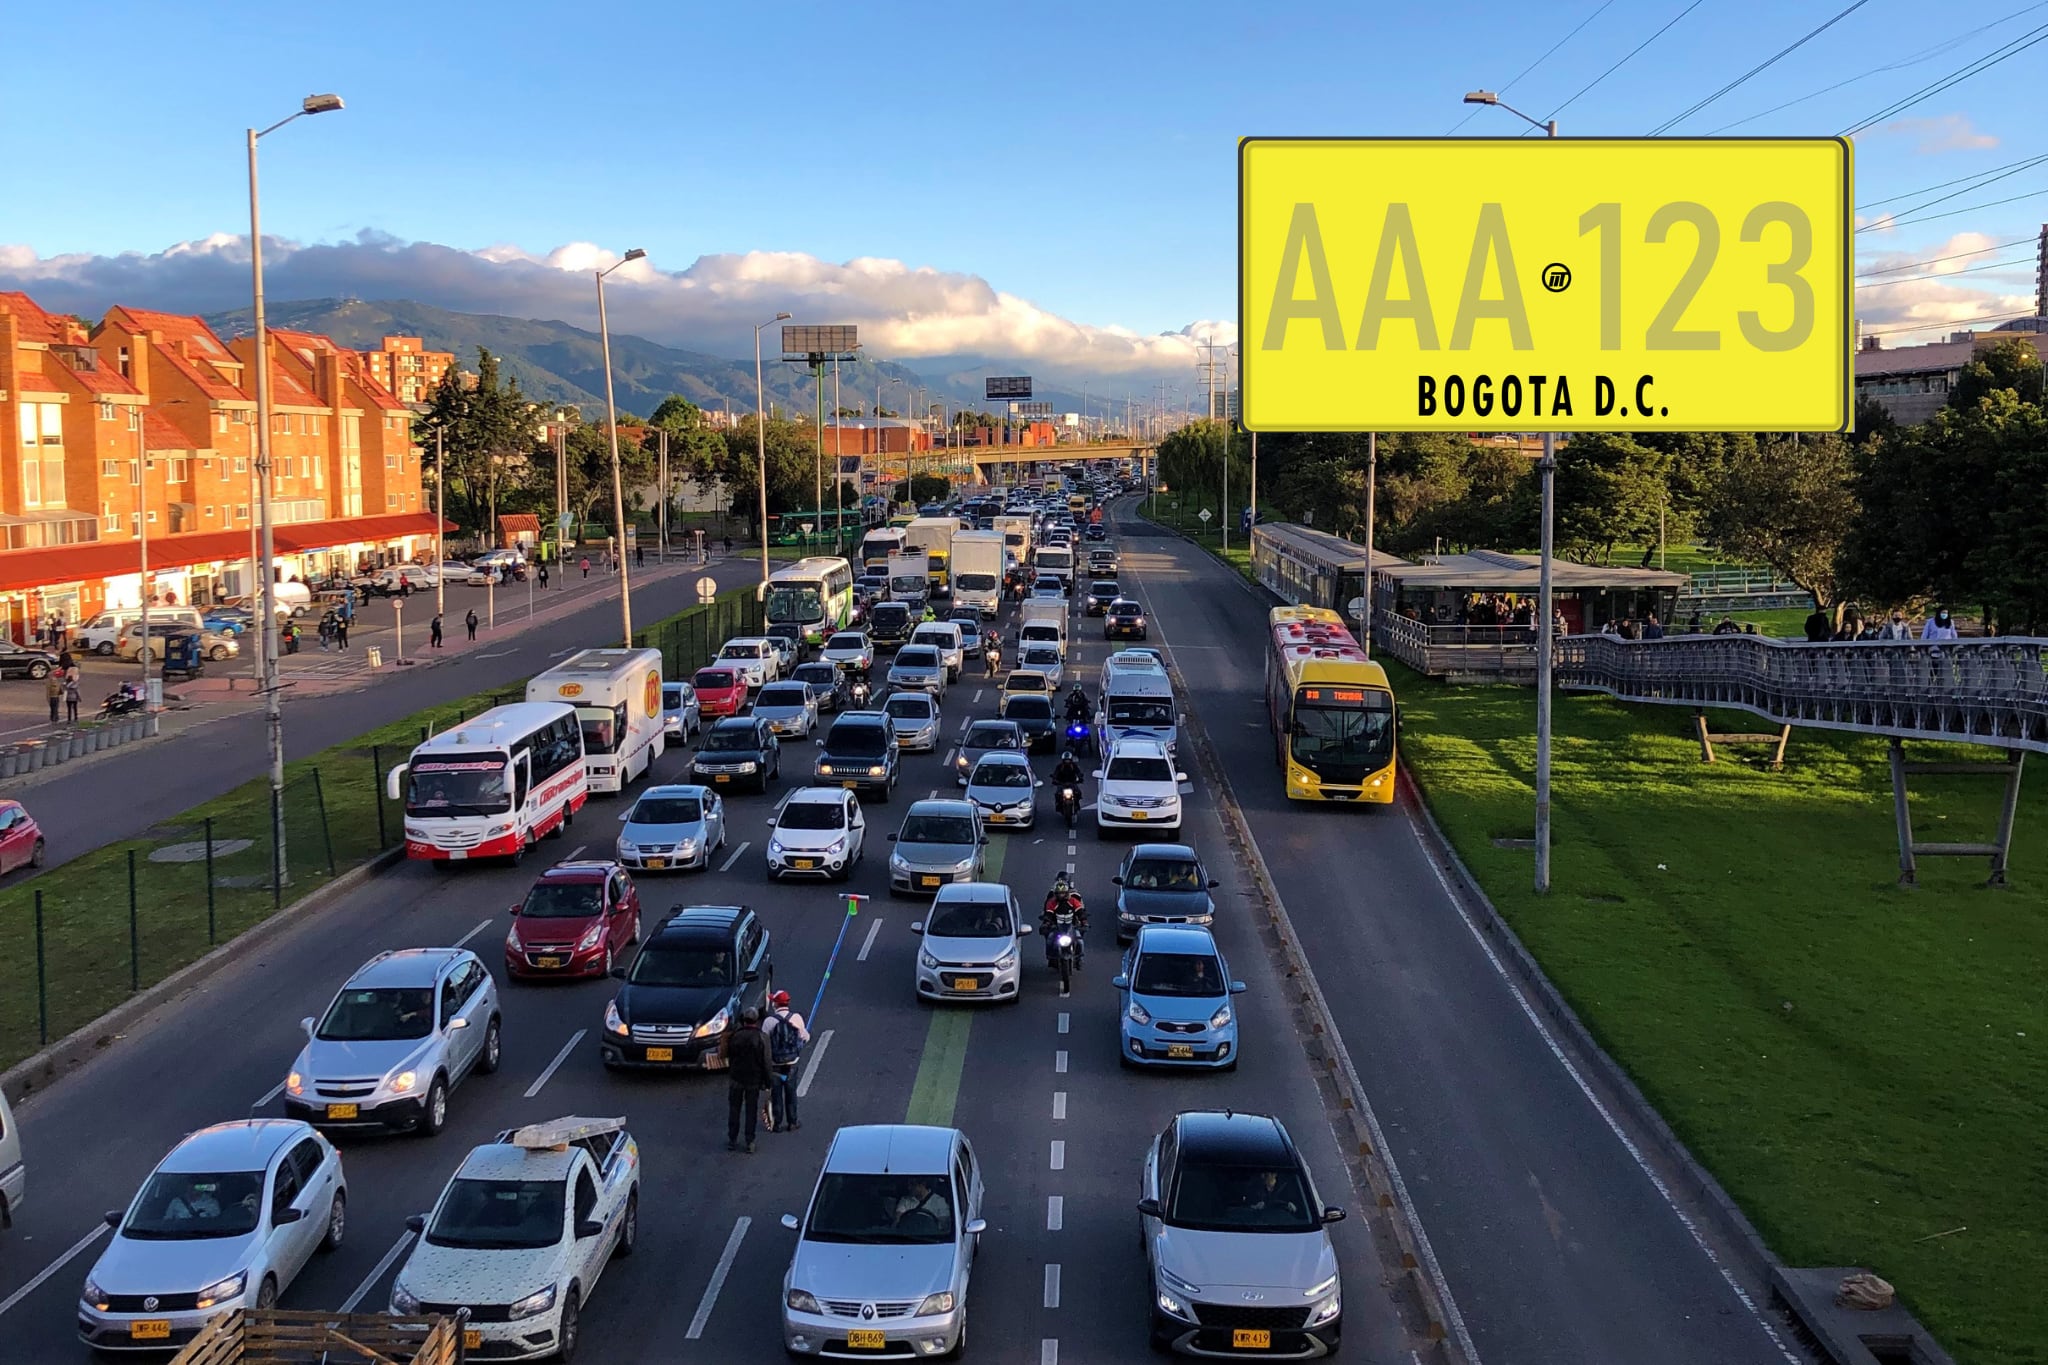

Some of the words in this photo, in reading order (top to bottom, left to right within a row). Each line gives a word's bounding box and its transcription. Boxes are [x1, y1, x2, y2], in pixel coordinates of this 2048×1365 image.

[561, 683, 582, 696] TCC
[645, 674, 660, 713] TCC
[867, 1330, 883, 1343] 869
[1253, 1333, 1269, 1343] 419
